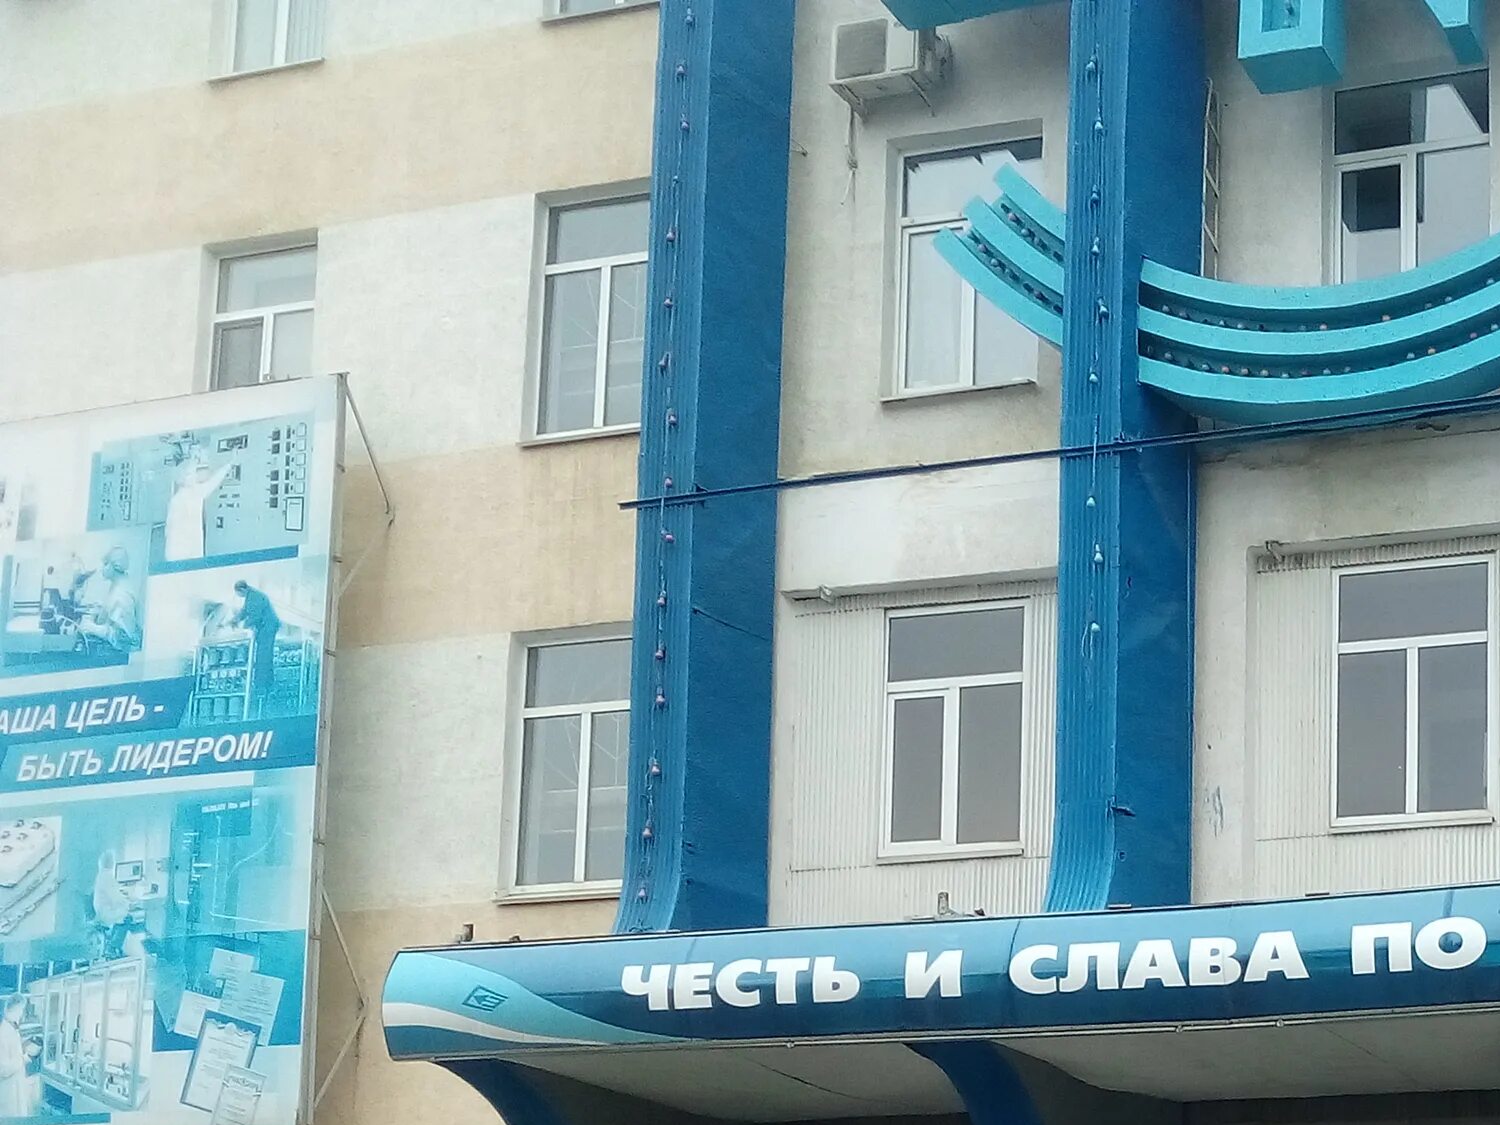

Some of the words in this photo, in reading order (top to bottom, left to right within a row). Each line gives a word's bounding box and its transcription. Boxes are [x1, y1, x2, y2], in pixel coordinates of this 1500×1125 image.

[64, 695, 146, 733] ЦЕЛЬ
[16, 748, 103, 782] БЫТЬ
[108, 730, 274, 775] ЛИДЕРОМ!
[621, 956, 860, 1011] ЧЕСТЬ
[903, 949, 964, 999] И
[1008, 930, 1310, 995] СЛАВА
[1350, 916, 1488, 976] ПО
